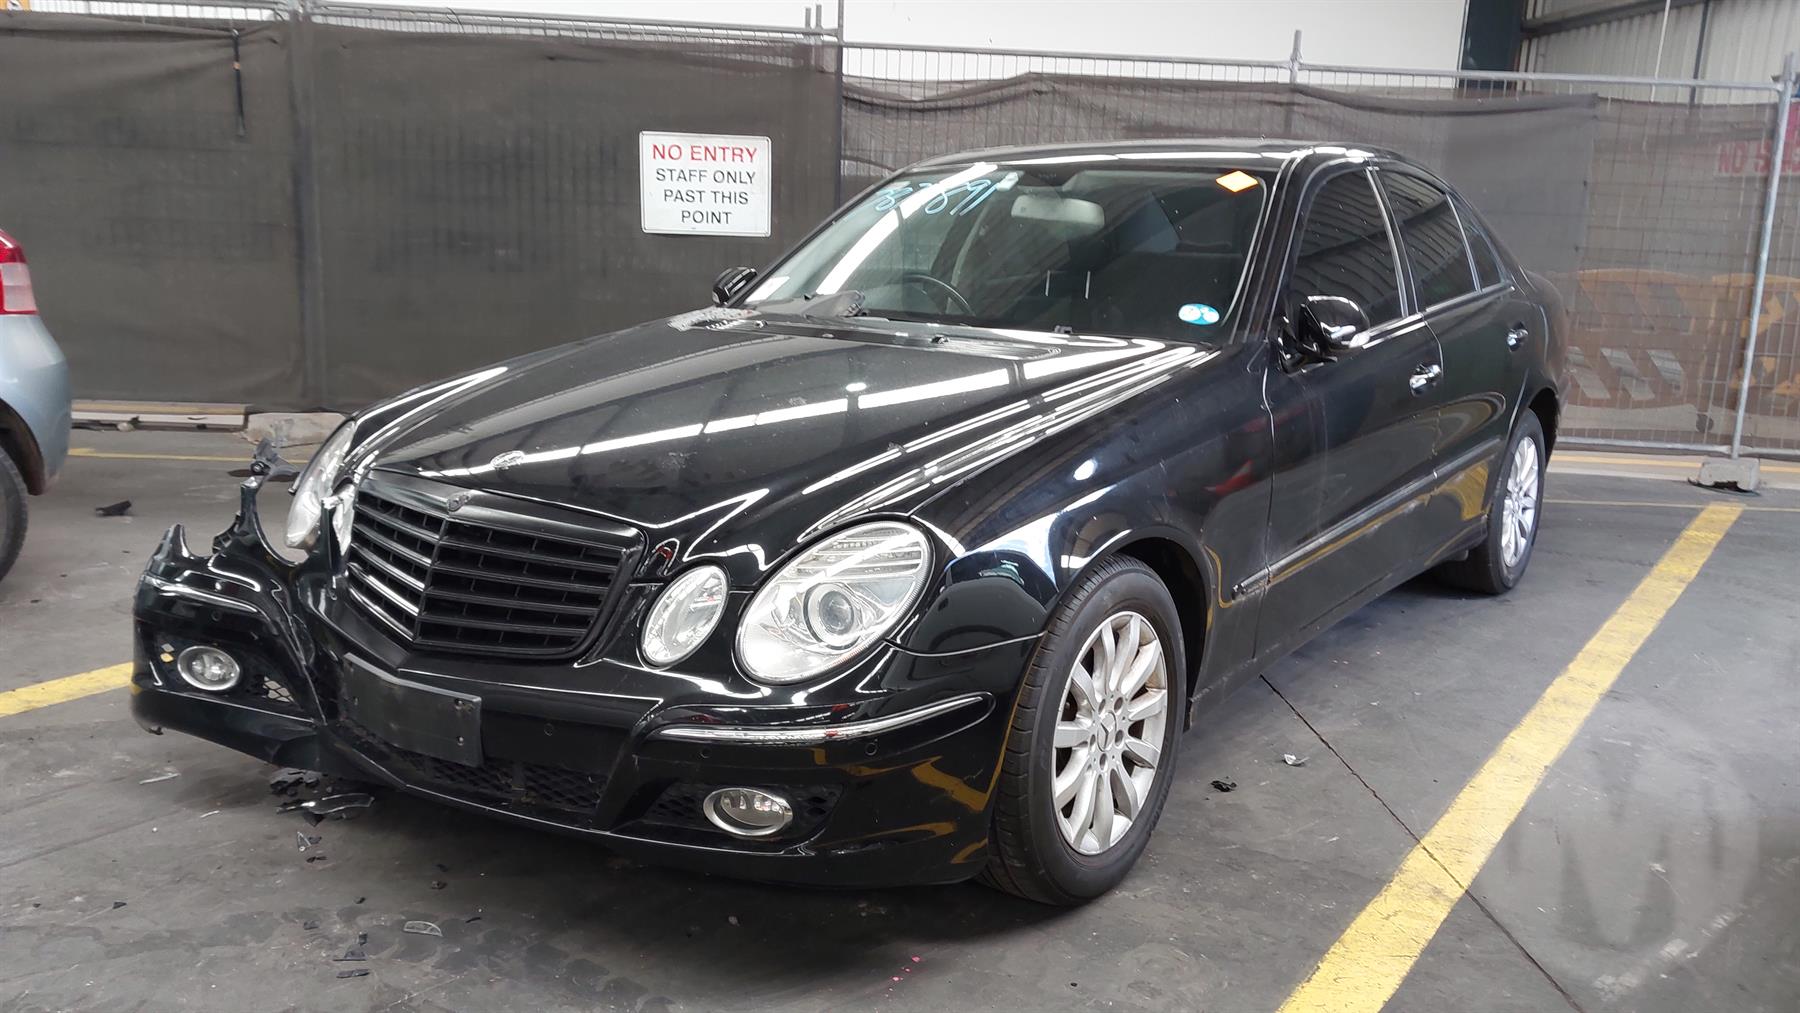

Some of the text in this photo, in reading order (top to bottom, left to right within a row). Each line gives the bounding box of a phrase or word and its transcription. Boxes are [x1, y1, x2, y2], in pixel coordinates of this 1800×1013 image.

[652, 144, 757, 163] NO ENTRY
[656, 168, 756, 184] STAFF ONLY
[664, 189, 749, 205] PAST THIS
[681, 210, 732, 225] POINT
